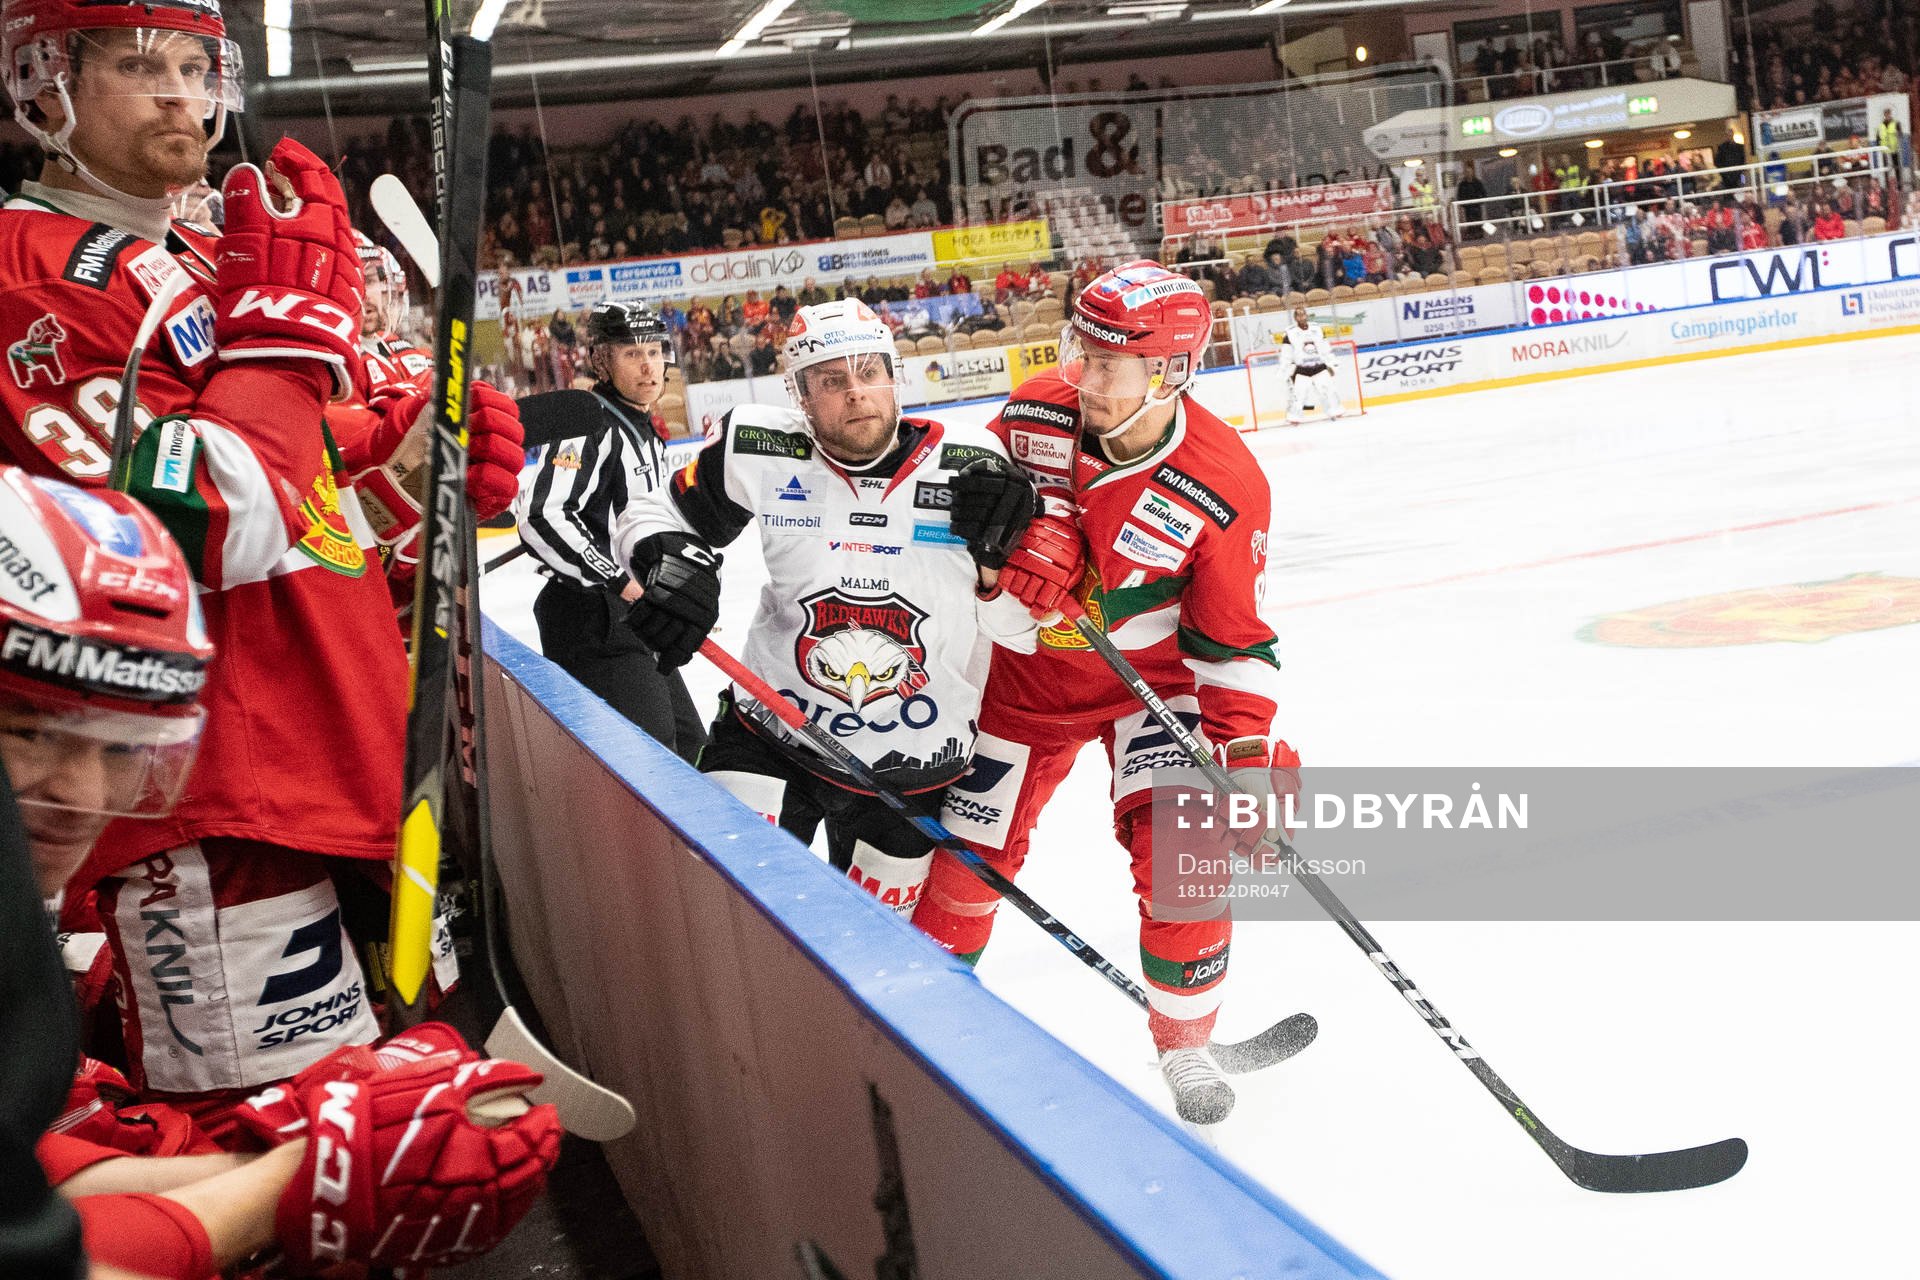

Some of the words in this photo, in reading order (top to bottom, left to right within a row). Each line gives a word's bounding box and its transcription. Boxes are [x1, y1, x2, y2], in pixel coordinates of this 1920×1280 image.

[978, 137, 1076, 186] Bad
[1086, 111, 1146, 178] &
[1404, 302, 1422, 324] N
[630, 320, 655, 329] CCM
[1671, 311, 1799, 339] Campingpärlor
[824, 329, 846, 340] OTTO
[824, 334, 877, 346] MAGNUSSON
[1174, 333, 1195, 341] CCM
[1360, 345, 1464, 369] JOHNS
[446, 318, 467, 423] SUPER
[1363, 360, 1464, 384] SPORT
[1400, 377, 1435, 388] MORA
[756, 440, 797, 457] HUSET
[1031, 440, 1055, 450] MORA
[1031, 448, 1067, 460] KOMMUN
[1080, 456, 1103, 471] SHL
[860, 478, 886, 490] SHL
[762, 514, 821, 528] Tillmobil
[850, 515, 887, 525] CCM
[1142, 502, 1192, 535] dalakraft
[842, 542, 904, 556] INTERSPORT
[98, 571, 181, 601] CCM
[841, 577, 890, 591] MALMÖ
[815, 601, 911, 638] REDHAWKS
[1231, 743, 1264, 755] CCM
[1121, 750, 1190, 771] JOHN
[943, 801, 999, 825] PORT
[945, 791, 1003, 818] OHNS
[1198, 938, 1226, 955] CCM
[253, 981, 362, 1034] JOHNS
[257, 1000, 361, 1050] SPORT
